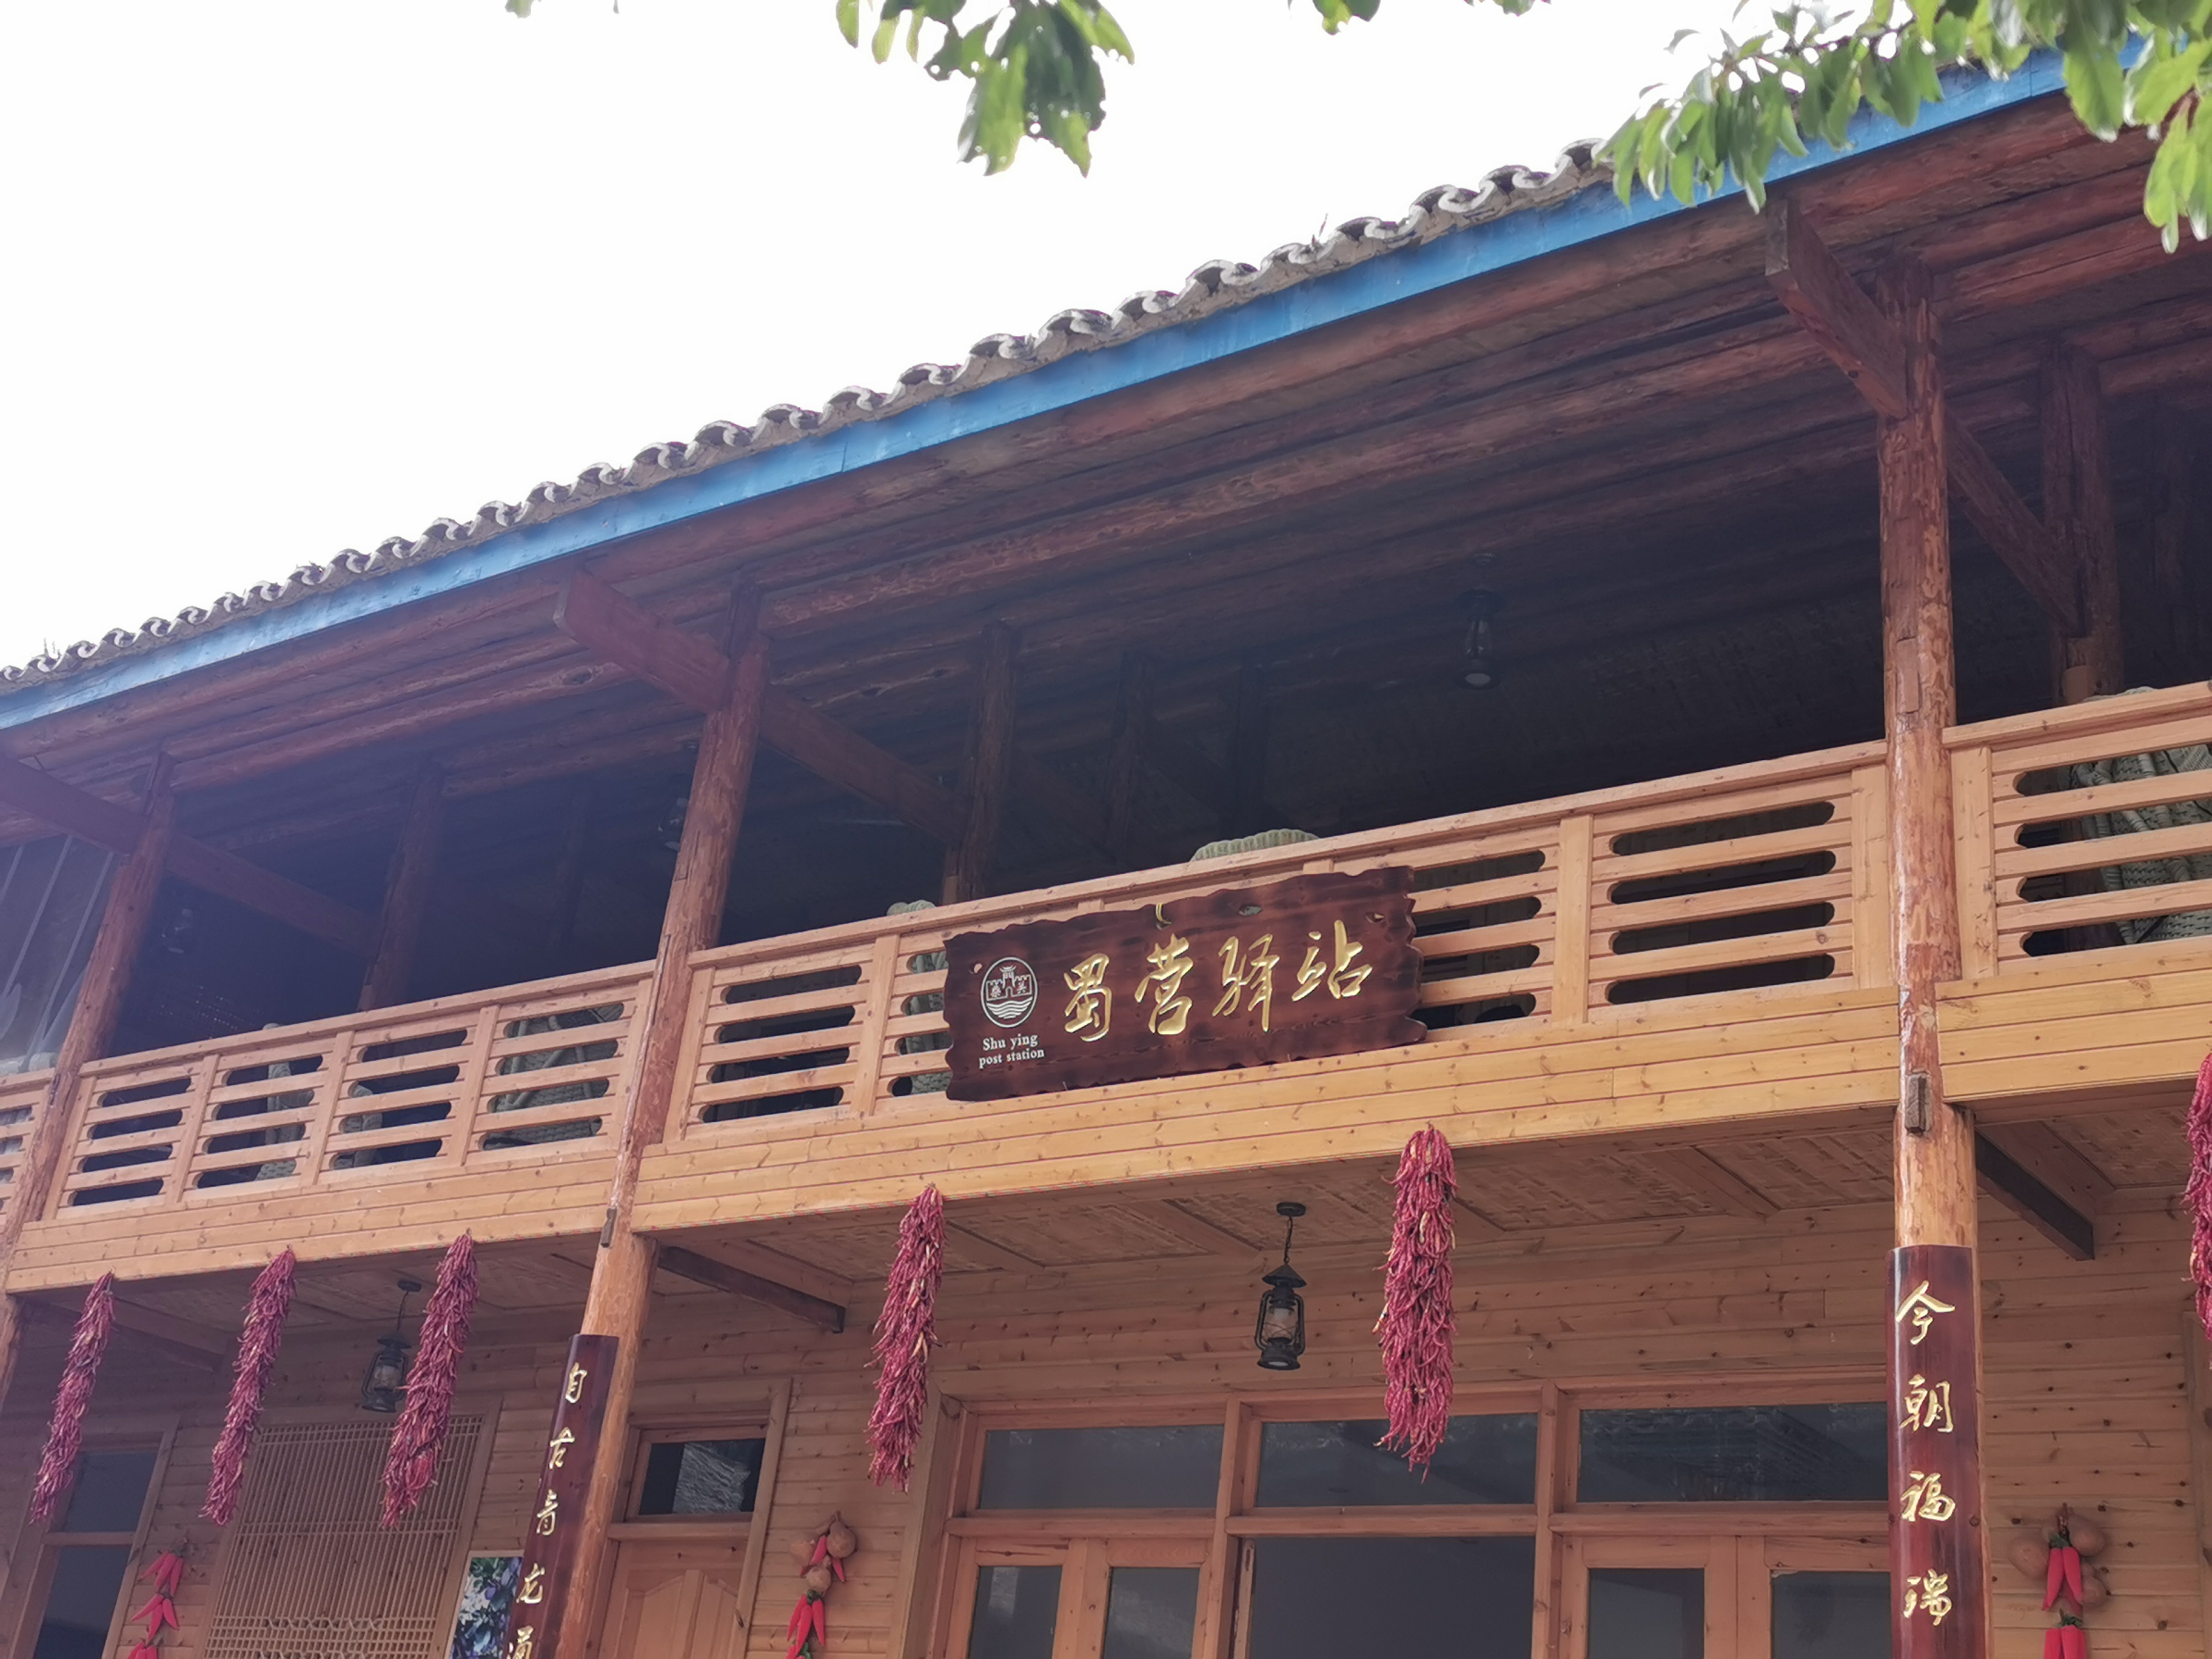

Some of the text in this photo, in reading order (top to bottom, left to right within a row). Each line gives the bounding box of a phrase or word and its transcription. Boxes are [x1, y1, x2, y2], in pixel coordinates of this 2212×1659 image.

[1064, 920, 1373, 1042] 蜀营驿站
[979, 1048, 1045, 1070] post station
[982, 1033, 1039, 1051] Shu ying
[1895, 1280, 1956, 1626] 今朝福瑞
